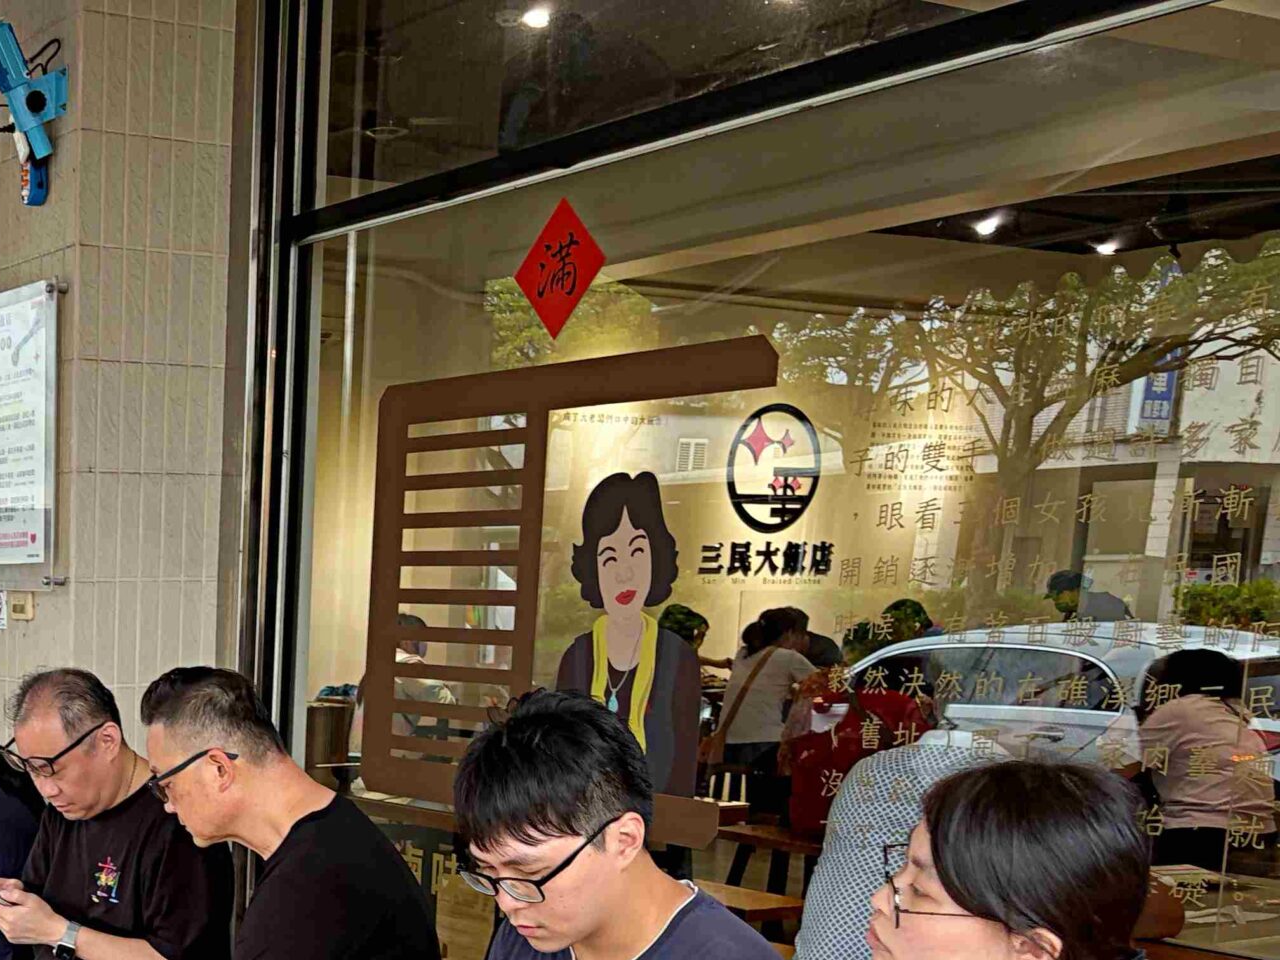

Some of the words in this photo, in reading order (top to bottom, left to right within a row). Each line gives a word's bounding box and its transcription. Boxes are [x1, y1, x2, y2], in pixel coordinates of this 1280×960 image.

[537, 231, 579, 298] 滿
[698, 541, 835, 577] 三民大飯店
